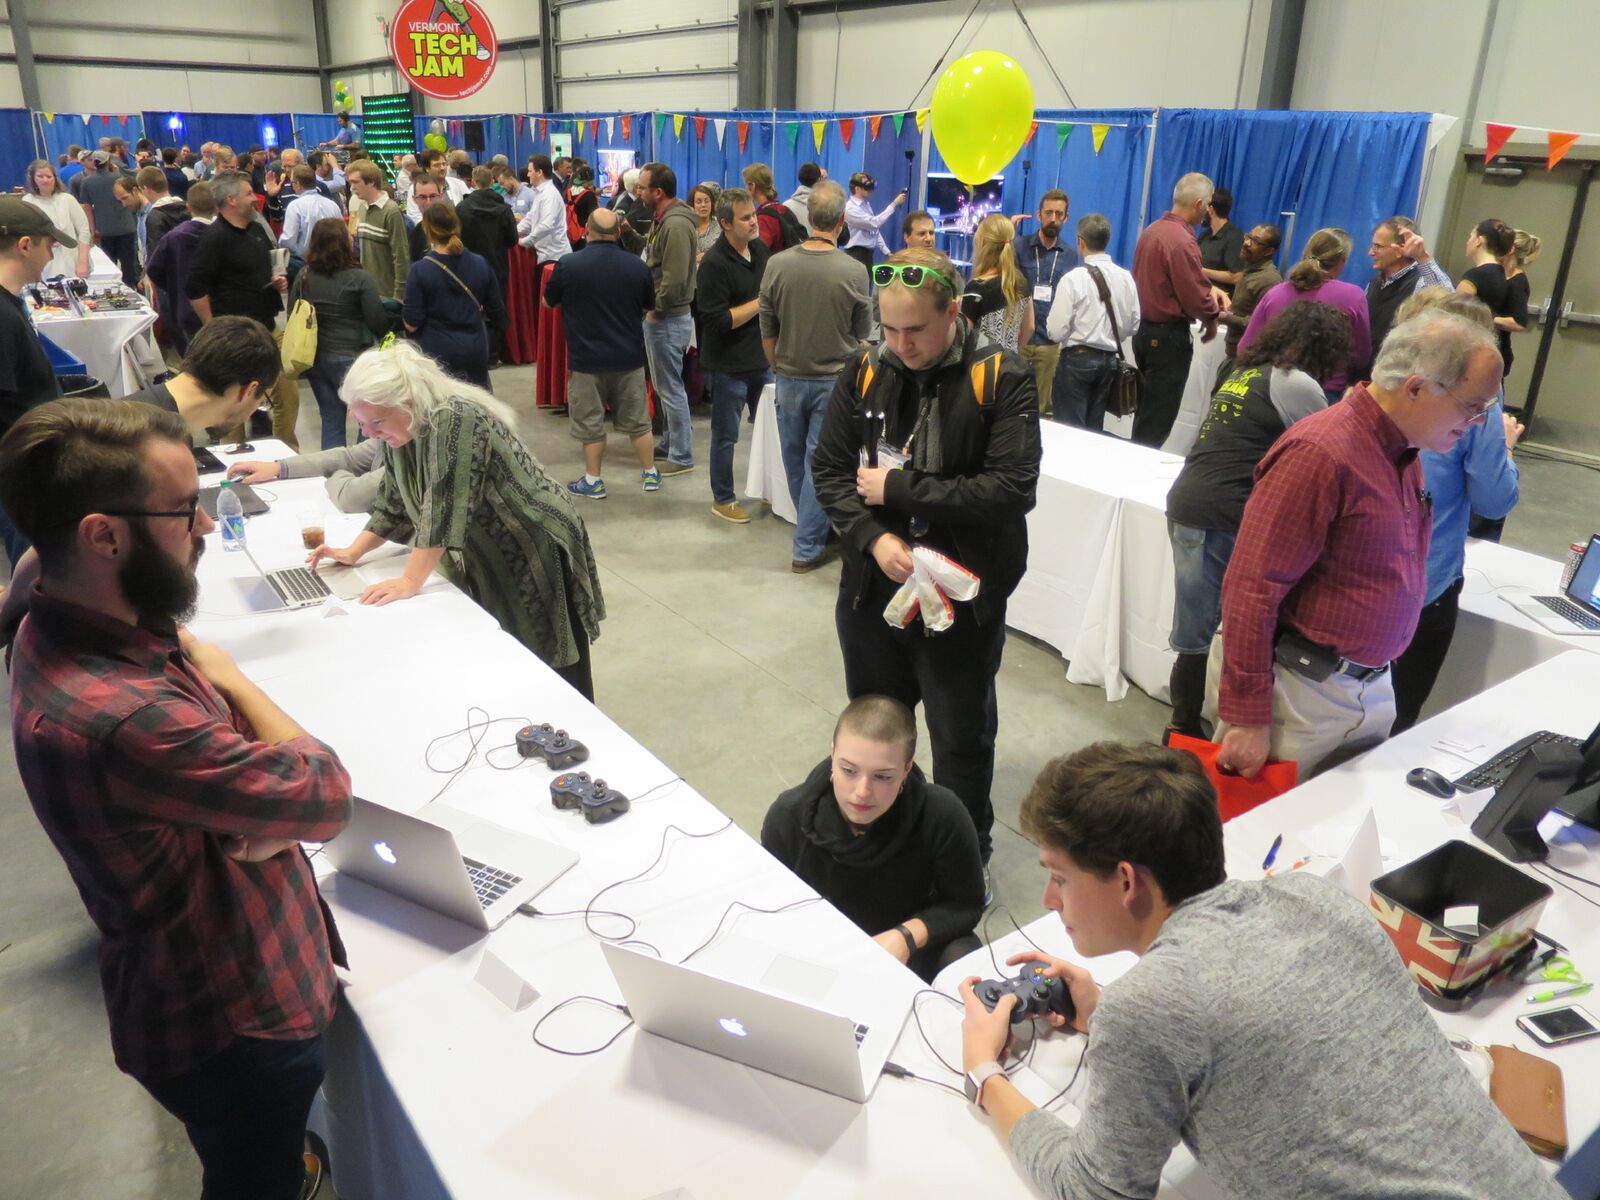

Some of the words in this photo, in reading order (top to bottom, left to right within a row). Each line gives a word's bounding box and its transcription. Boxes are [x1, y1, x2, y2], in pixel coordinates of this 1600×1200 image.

[409, 22, 460, 33] VERMONT
[409, 33, 477, 56] TECH
[409, 55, 464, 77] JAM
